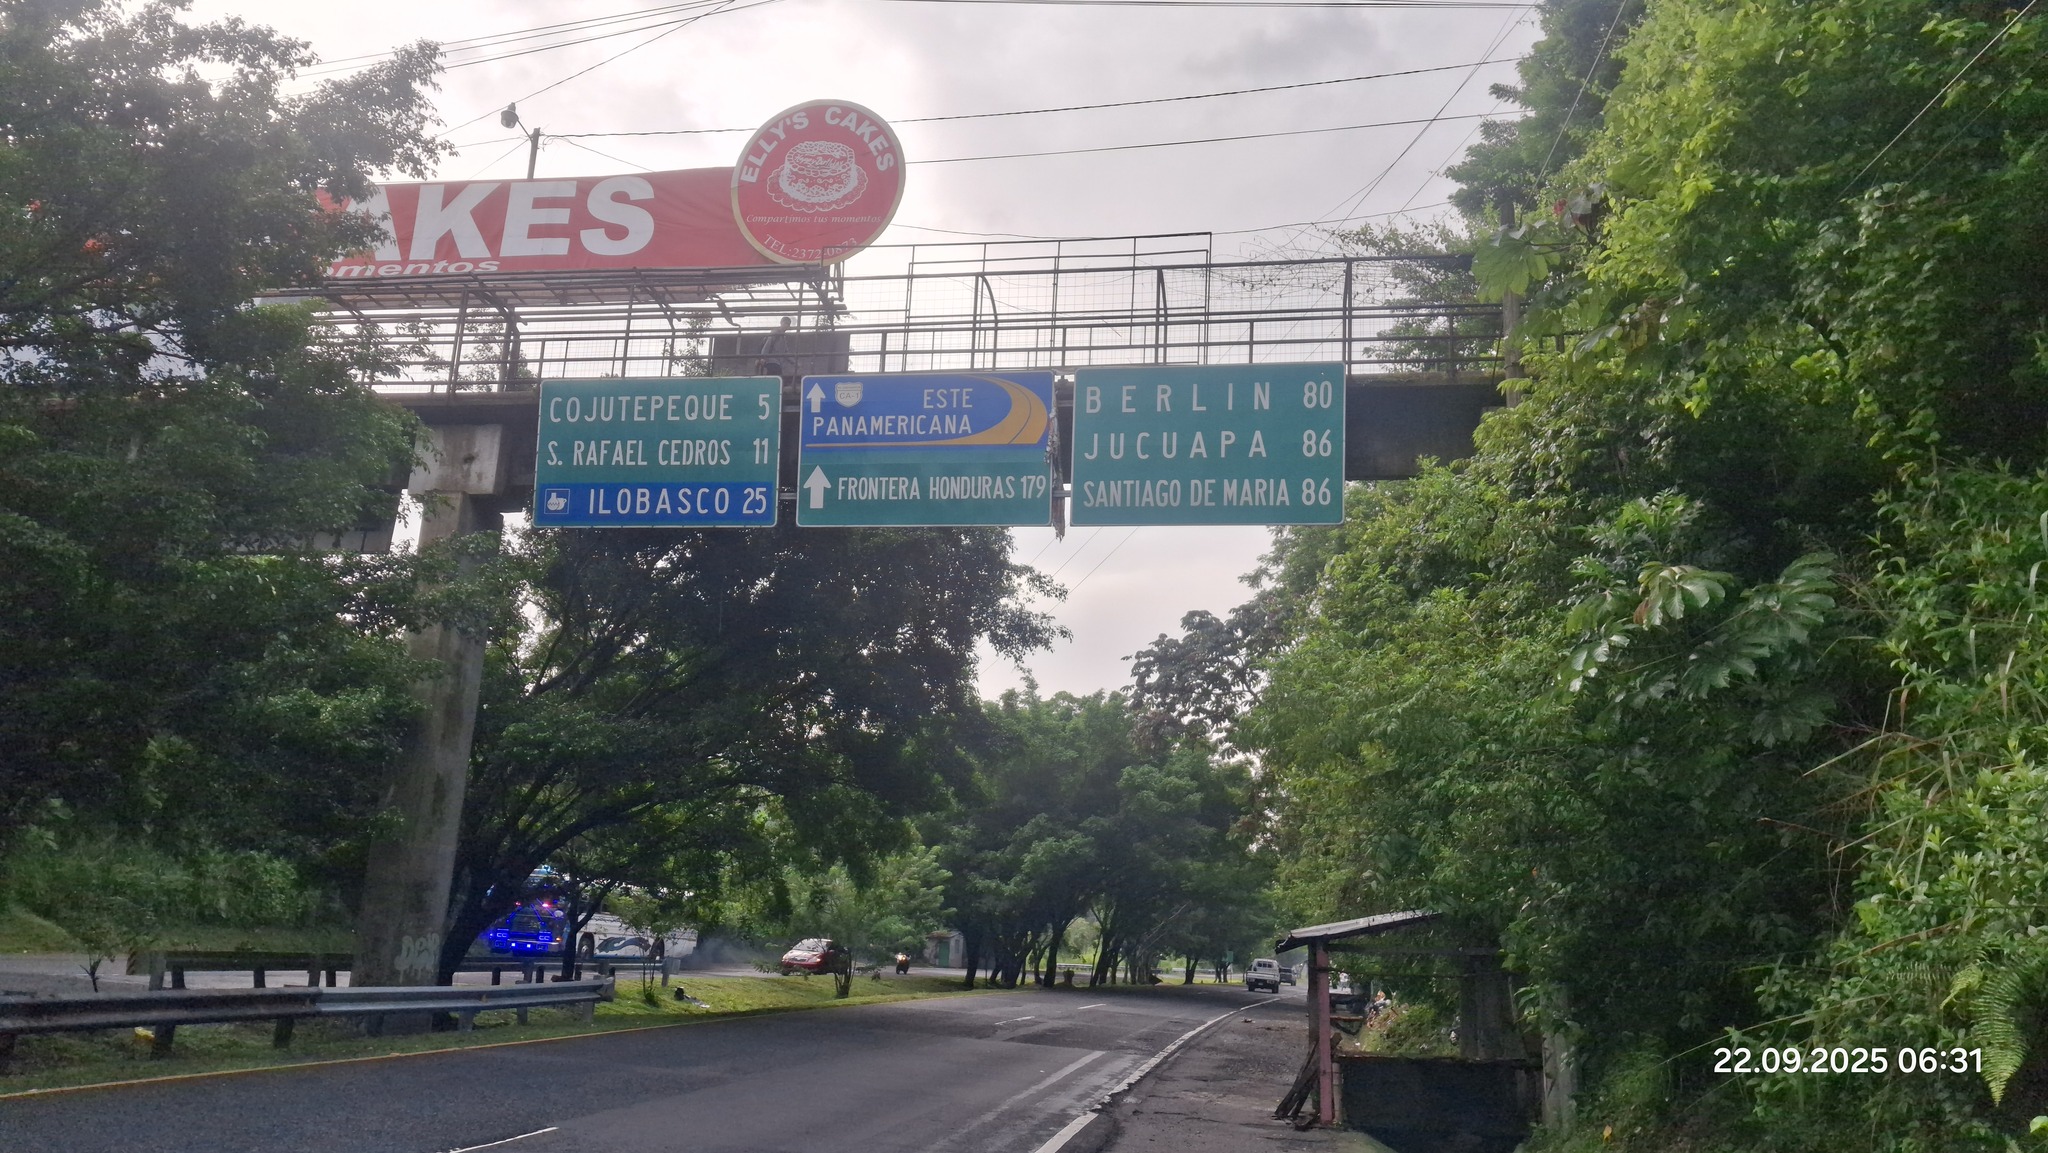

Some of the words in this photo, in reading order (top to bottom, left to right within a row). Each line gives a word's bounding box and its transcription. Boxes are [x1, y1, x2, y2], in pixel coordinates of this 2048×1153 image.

[740, 111, 810, 183] ELLY'S
[824, 106, 895, 172] CAKES
[329, 175, 656, 263] AKES
[813, 215, 828, 223] tus
[831, 214, 881, 224] momentos
[550, 394, 734, 423] COJUTEPEQUE
[758, 393, 770, 420] 5
[923, 388, 974, 409] ESTE
[1302, 380, 1333, 409] 80
[813, 414, 973, 436] PANAMERICANA
[547, 440, 563, 466] S.
[573, 439, 648, 466] RAFAEL
[658, 439, 731, 466] CEDROS
[753, 437, 769, 465] 11
[1083, 429, 1267, 460] JUCUAPA
[1302, 429, 1332, 458] 86
[588, 487, 730, 515] ILOBASCO
[742, 487, 767, 515] 25
[837, 476, 921, 500] FRONTERA
[929, 475, 1016, 500] HONDURAS
[1020, 475, 1047, 500] 179
[1083, 479, 1181, 508] SANTIAGO
[1190, 478, 1216, 507] DE
[1223, 478, 1290, 507] MARIA
[1301, 477, 1331, 506] 86
